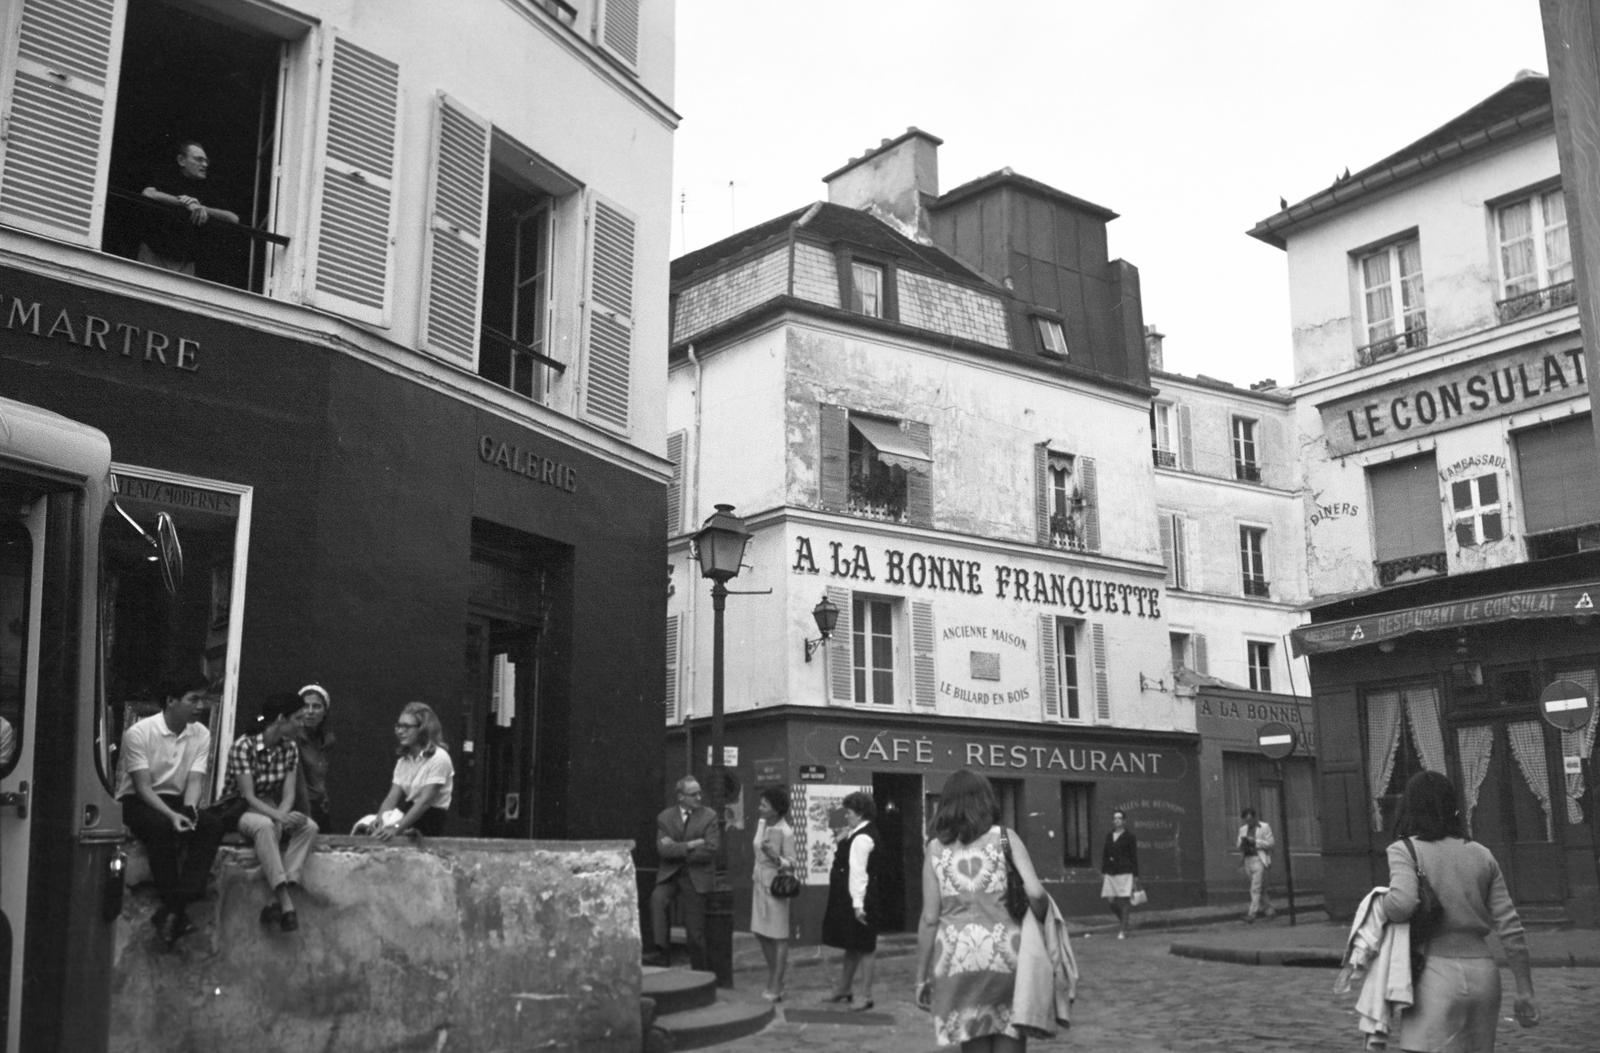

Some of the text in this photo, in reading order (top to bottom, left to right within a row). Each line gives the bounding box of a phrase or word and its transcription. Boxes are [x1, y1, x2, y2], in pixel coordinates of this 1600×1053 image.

[0, 294, 201, 372] MARTRE
[1347, 348, 1586, 442] LE CONSULAT
[478, 434, 577, 494] GALERIE
[1310, 502, 1359, 527] DINERS
[792, 536, 1162, 619] A LA BONNE FRANQUETTE
[1377, 593, 1557, 636] RESTAURANT LE CONSULAT
[942, 626, 1028, 651] ANCIENNE MAISON
[940, 681, 1030, 706] LE BILLARD EN BOIS
[1200, 699, 1299, 724] A LA BONNE
[966, 742, 1163, 774] RESTAURANT
